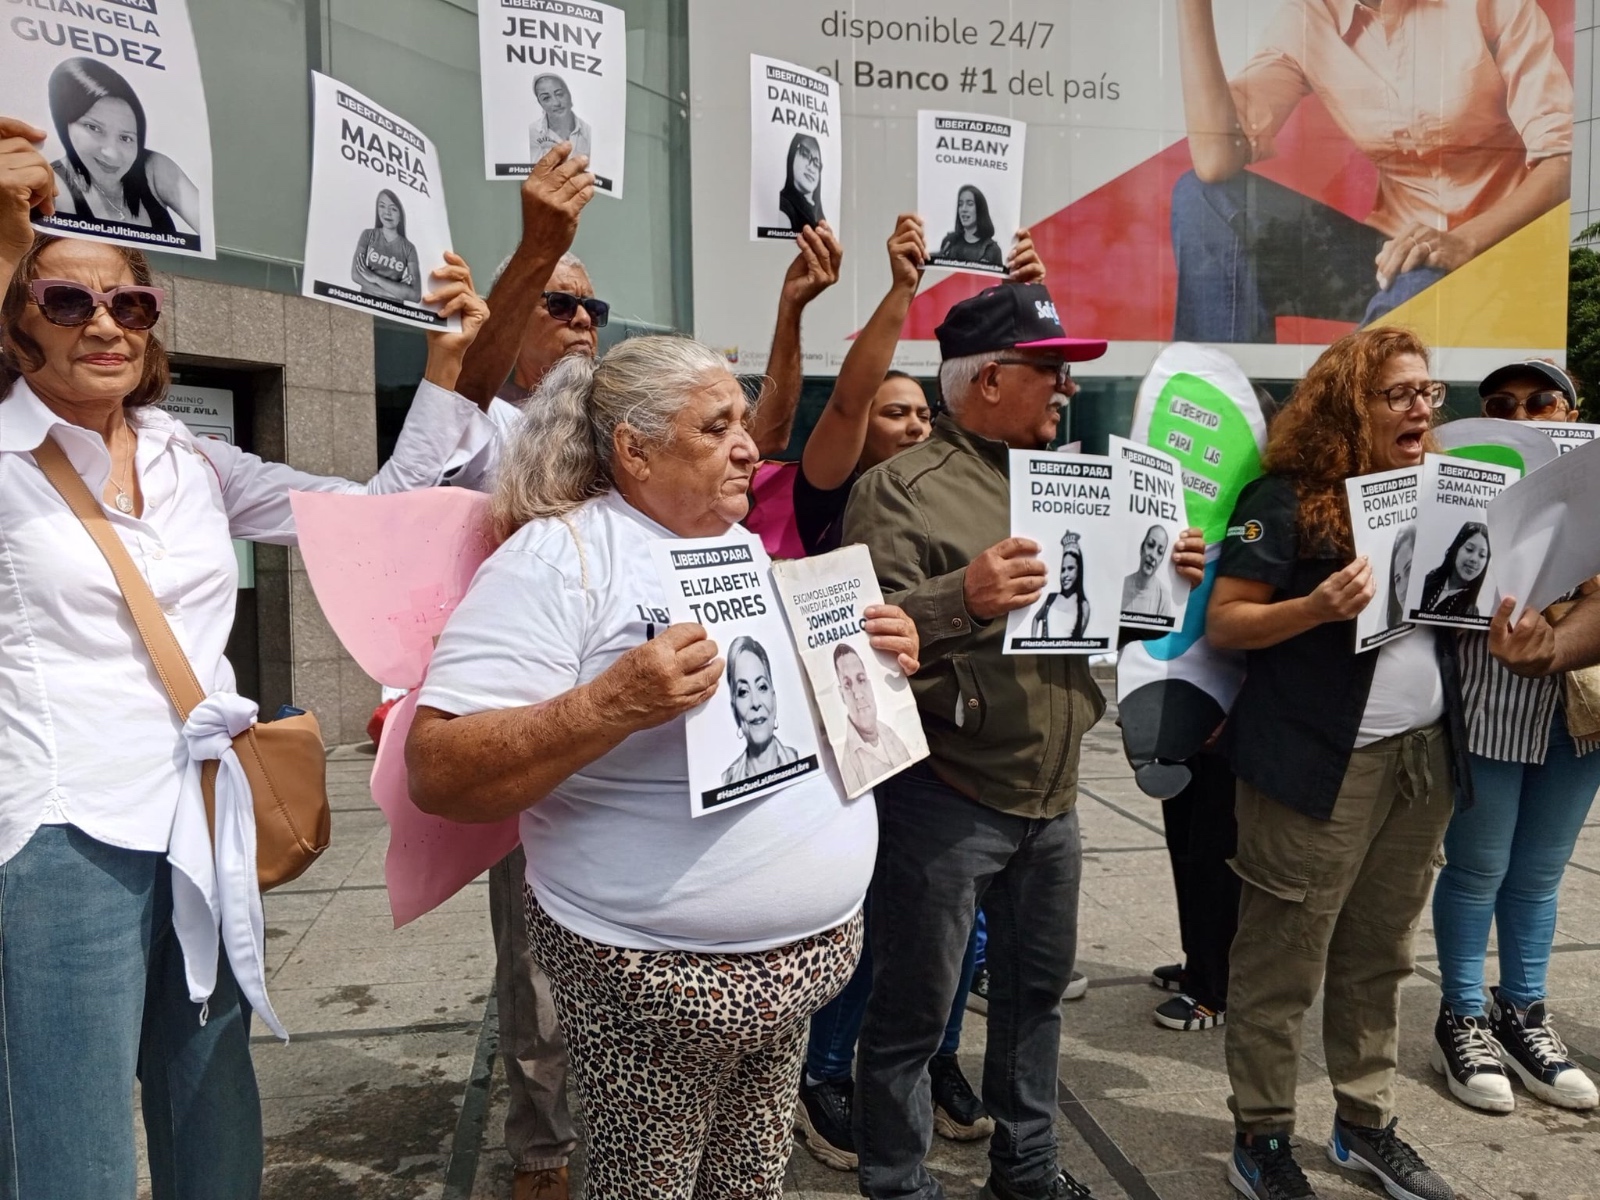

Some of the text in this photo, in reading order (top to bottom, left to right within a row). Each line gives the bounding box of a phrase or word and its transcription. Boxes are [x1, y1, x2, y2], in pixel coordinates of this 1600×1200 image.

[567, 7, 600, 21] PARA
[502, 16, 602, 50] JENNY
[821, 10, 1055, 50] disponible 24/7
[10, 16, 166, 71] GUEDEZ
[506, 44, 603, 77] NUÑEZ
[767, 67, 828, 94] LIBERTAD PARA
[855, 61, 949, 92] Banco
[960, 66, 998, 95] #1
[1008, 69, 1054, 97] del
[1064, 72, 1121, 104] país
[768, 85, 829, 116] DANIELA
[338, 93, 424, 150] LIBERTAD PARA
[771, 106, 829, 137] ARAÑA
[936, 119, 1009, 135] LIBERTAD PARA
[936, 136, 1009, 157] ALBANY
[340, 144, 430, 198] OROPEZA
[935, 153, 1008, 171] COLMENARES
[43, 215, 186, 245] #HastaQueLaUltimaseaLibre
[328, 287, 434, 322] #HastaQueLaUltimaseaLibre
[193, 407, 219, 415] AVILA
[1170, 399, 1218, 428] LIBERTAD
[1568, 430, 1593, 439] PARA
[1122, 449, 1172, 472] LIBERTAD PARA
[1168, 433, 1220, 464] PARA LAS
[1030, 461, 1109, 478] LIBERTAD PARA
[1439, 466, 1504, 483] LIBERTAD PARA
[1031, 481, 1110, 500] DAIVIANA
[1129, 470, 1175, 499] ENNY
[1361, 477, 1416, 495] LIBERTAD PARA
[1032, 499, 1110, 516] RODRÍGUEZ
[1363, 489, 1417, 513] ROMAYER
[1367, 506, 1418, 530] CASTILLO
[671, 548, 750, 567] LIBERTAD PARA
[680, 571, 761, 597] ELIZABETH
[689, 594, 767, 625] TORRES
[834, 591, 858, 605] PARA
[806, 604, 855, 631] JOHNDRY
